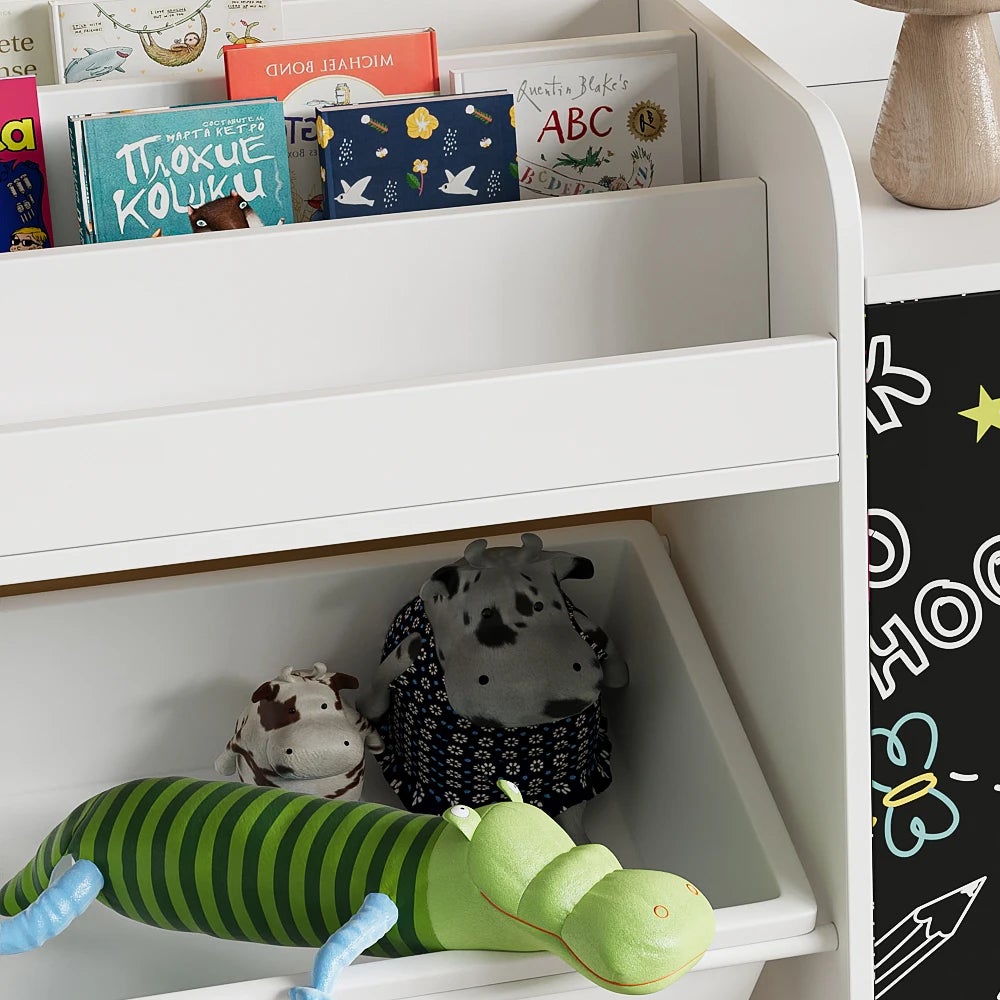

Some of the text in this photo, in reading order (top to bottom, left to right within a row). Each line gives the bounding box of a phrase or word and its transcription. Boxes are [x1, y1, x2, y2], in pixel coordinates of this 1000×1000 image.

[517, 73, 629, 113] Quentin Blake's
[0, 116, 38, 152] a
[166, 121, 265, 144] МАРТА КЕТРО
[537, 105, 614, 144] ABC
